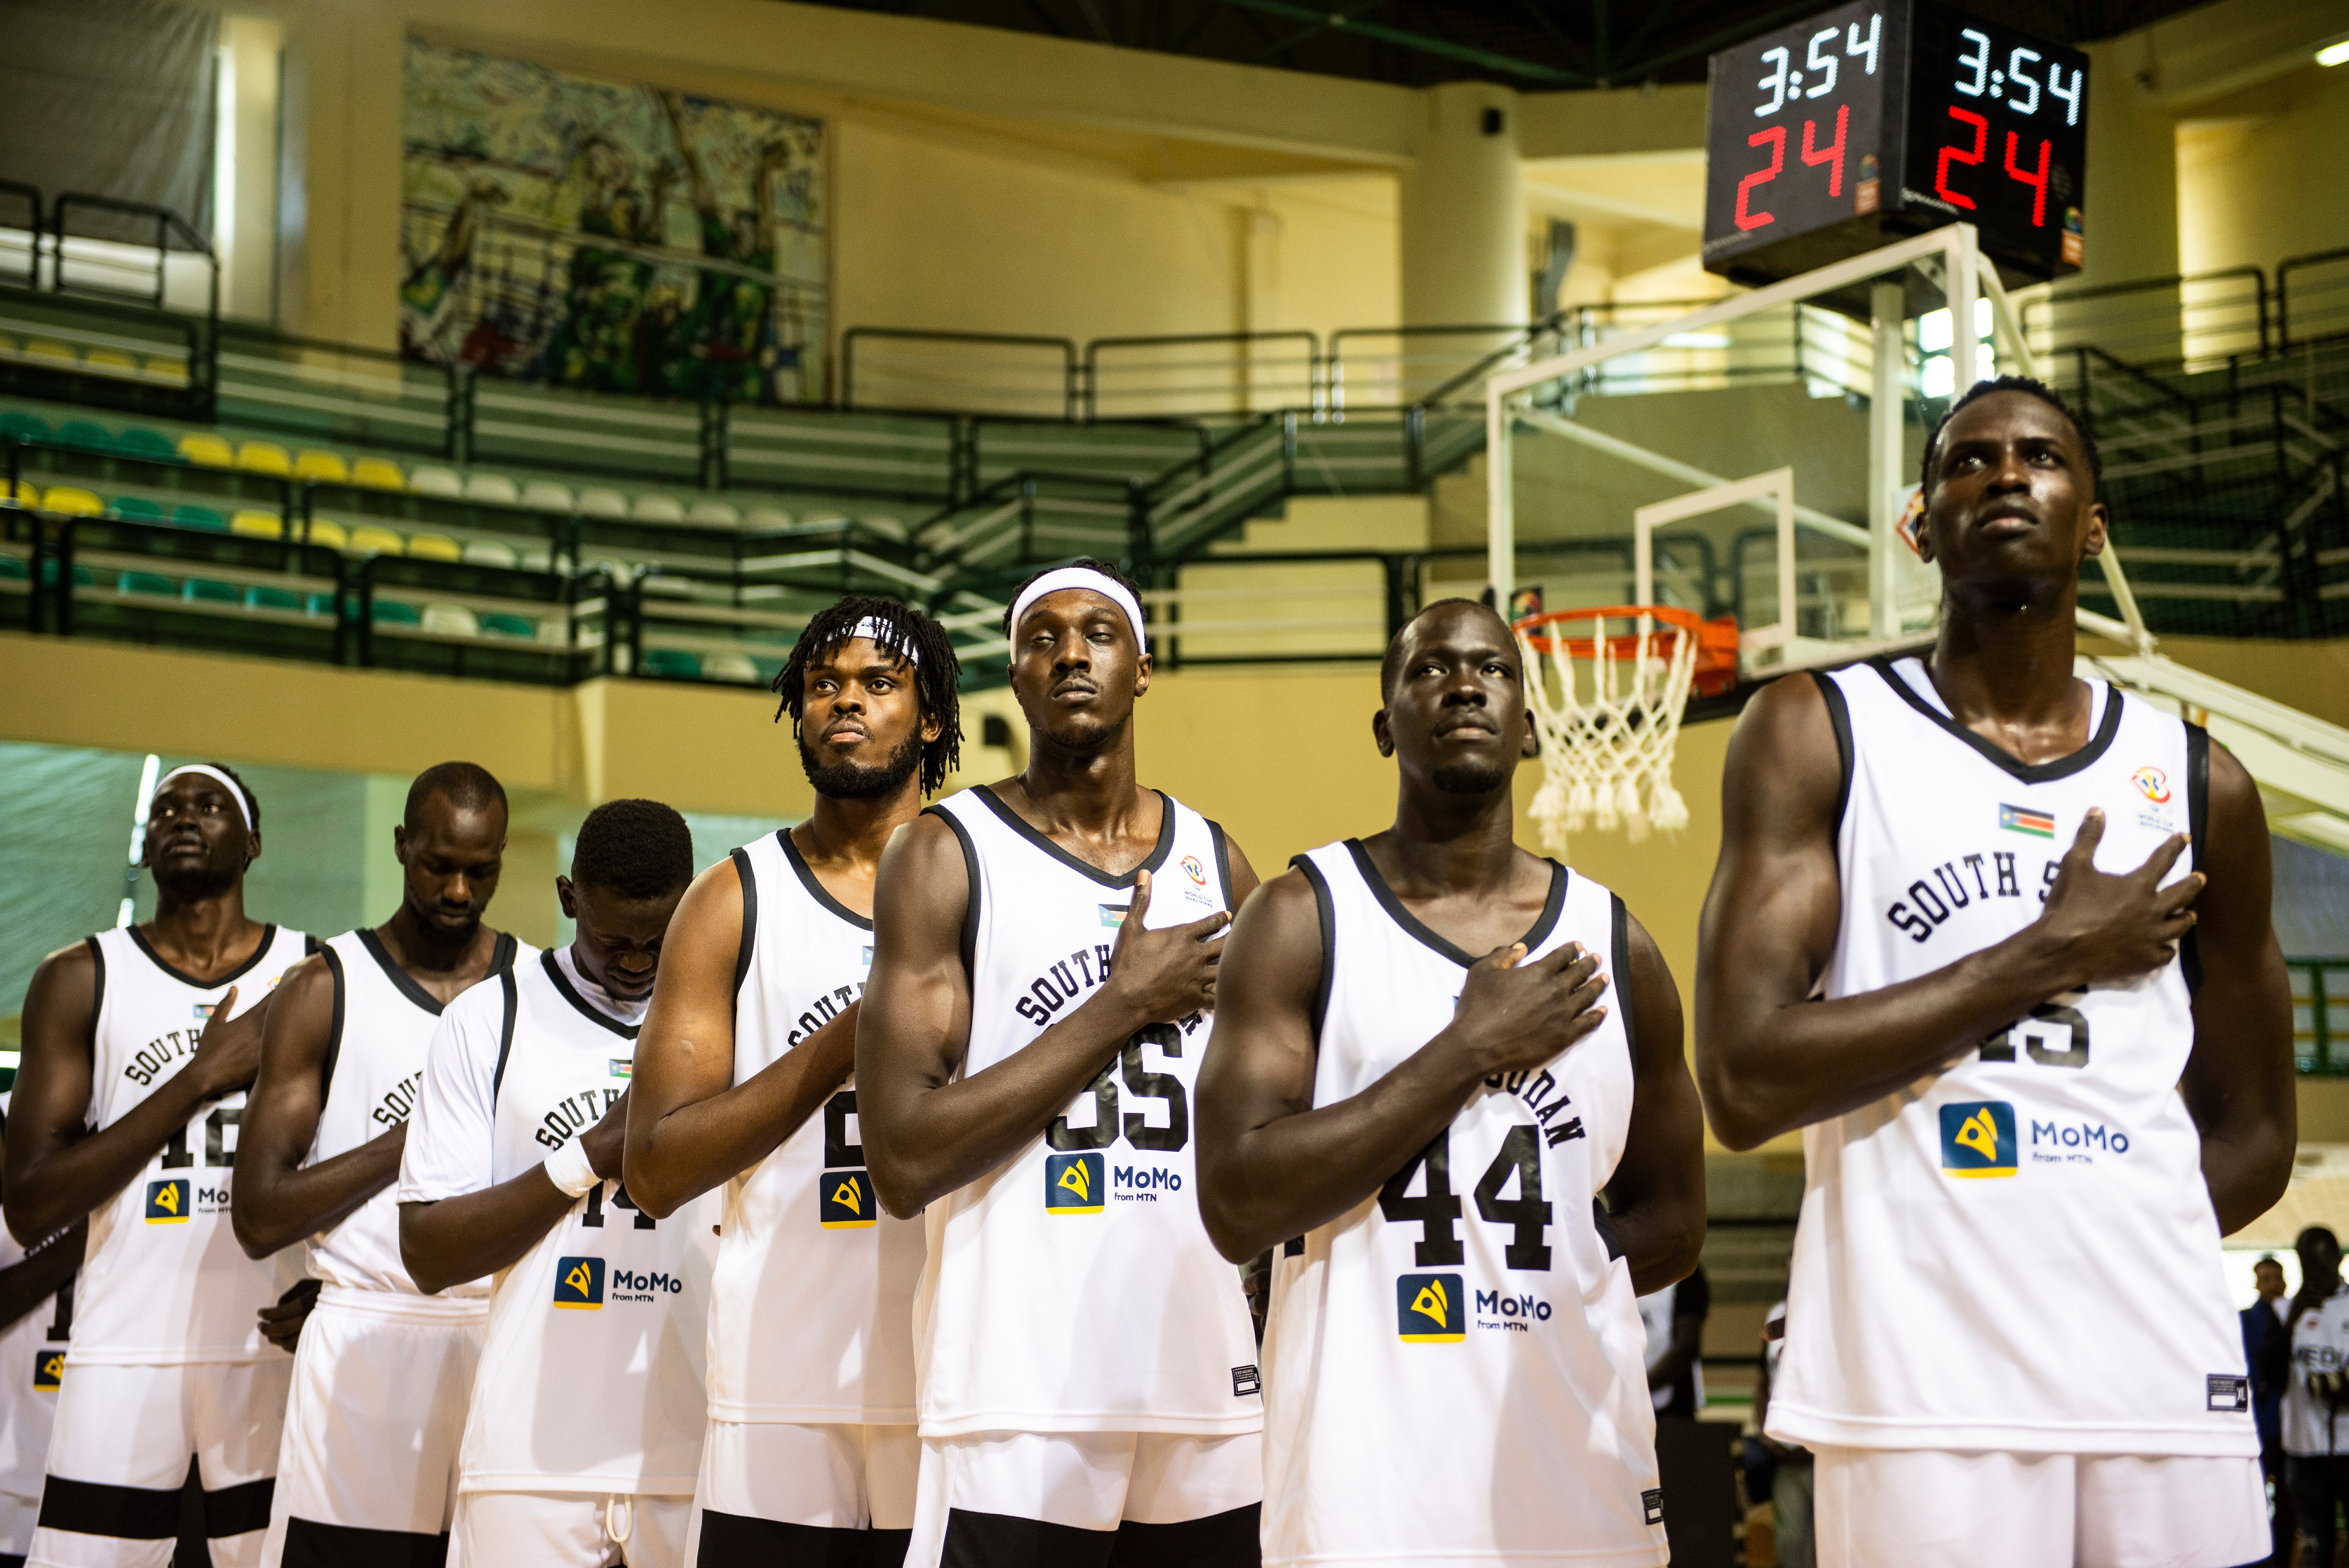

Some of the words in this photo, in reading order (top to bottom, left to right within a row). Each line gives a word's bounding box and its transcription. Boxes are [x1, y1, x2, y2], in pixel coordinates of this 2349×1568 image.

[1754, 14, 1882, 118] 3:54
[1954, 28, 2083, 126] 3:54
[1735, 104, 1850, 231] 24
[1935, 105, 2052, 228] 24
[1184, 890, 1203, 899] WORLD
[1185, 896, 1213, 908] QUALIFIERS
[1887, 851, 2020, 943] SOUTH
[787, 982, 865, 1047] SOUT
[1015, 944, 1110, 1026] SOUTH
[124, 1028, 202, 1087] SOUTH
[372, 1070, 423, 1130] SOU
[2031, 1119, 2128, 1154] MoMo
[1114, 1166, 1182, 1191] MoMo
[1115, 1192, 1134, 1201] from
[1377, 1124, 1553, 1272] 44
[612, 1293, 633, 1301] from
[613, 1270, 682, 1294] MoMo
[1476, 1289, 1551, 1321] MoMo
[1478, 1320, 1500, 1329] from
[1504, 1322, 1528, 1332] MTN
